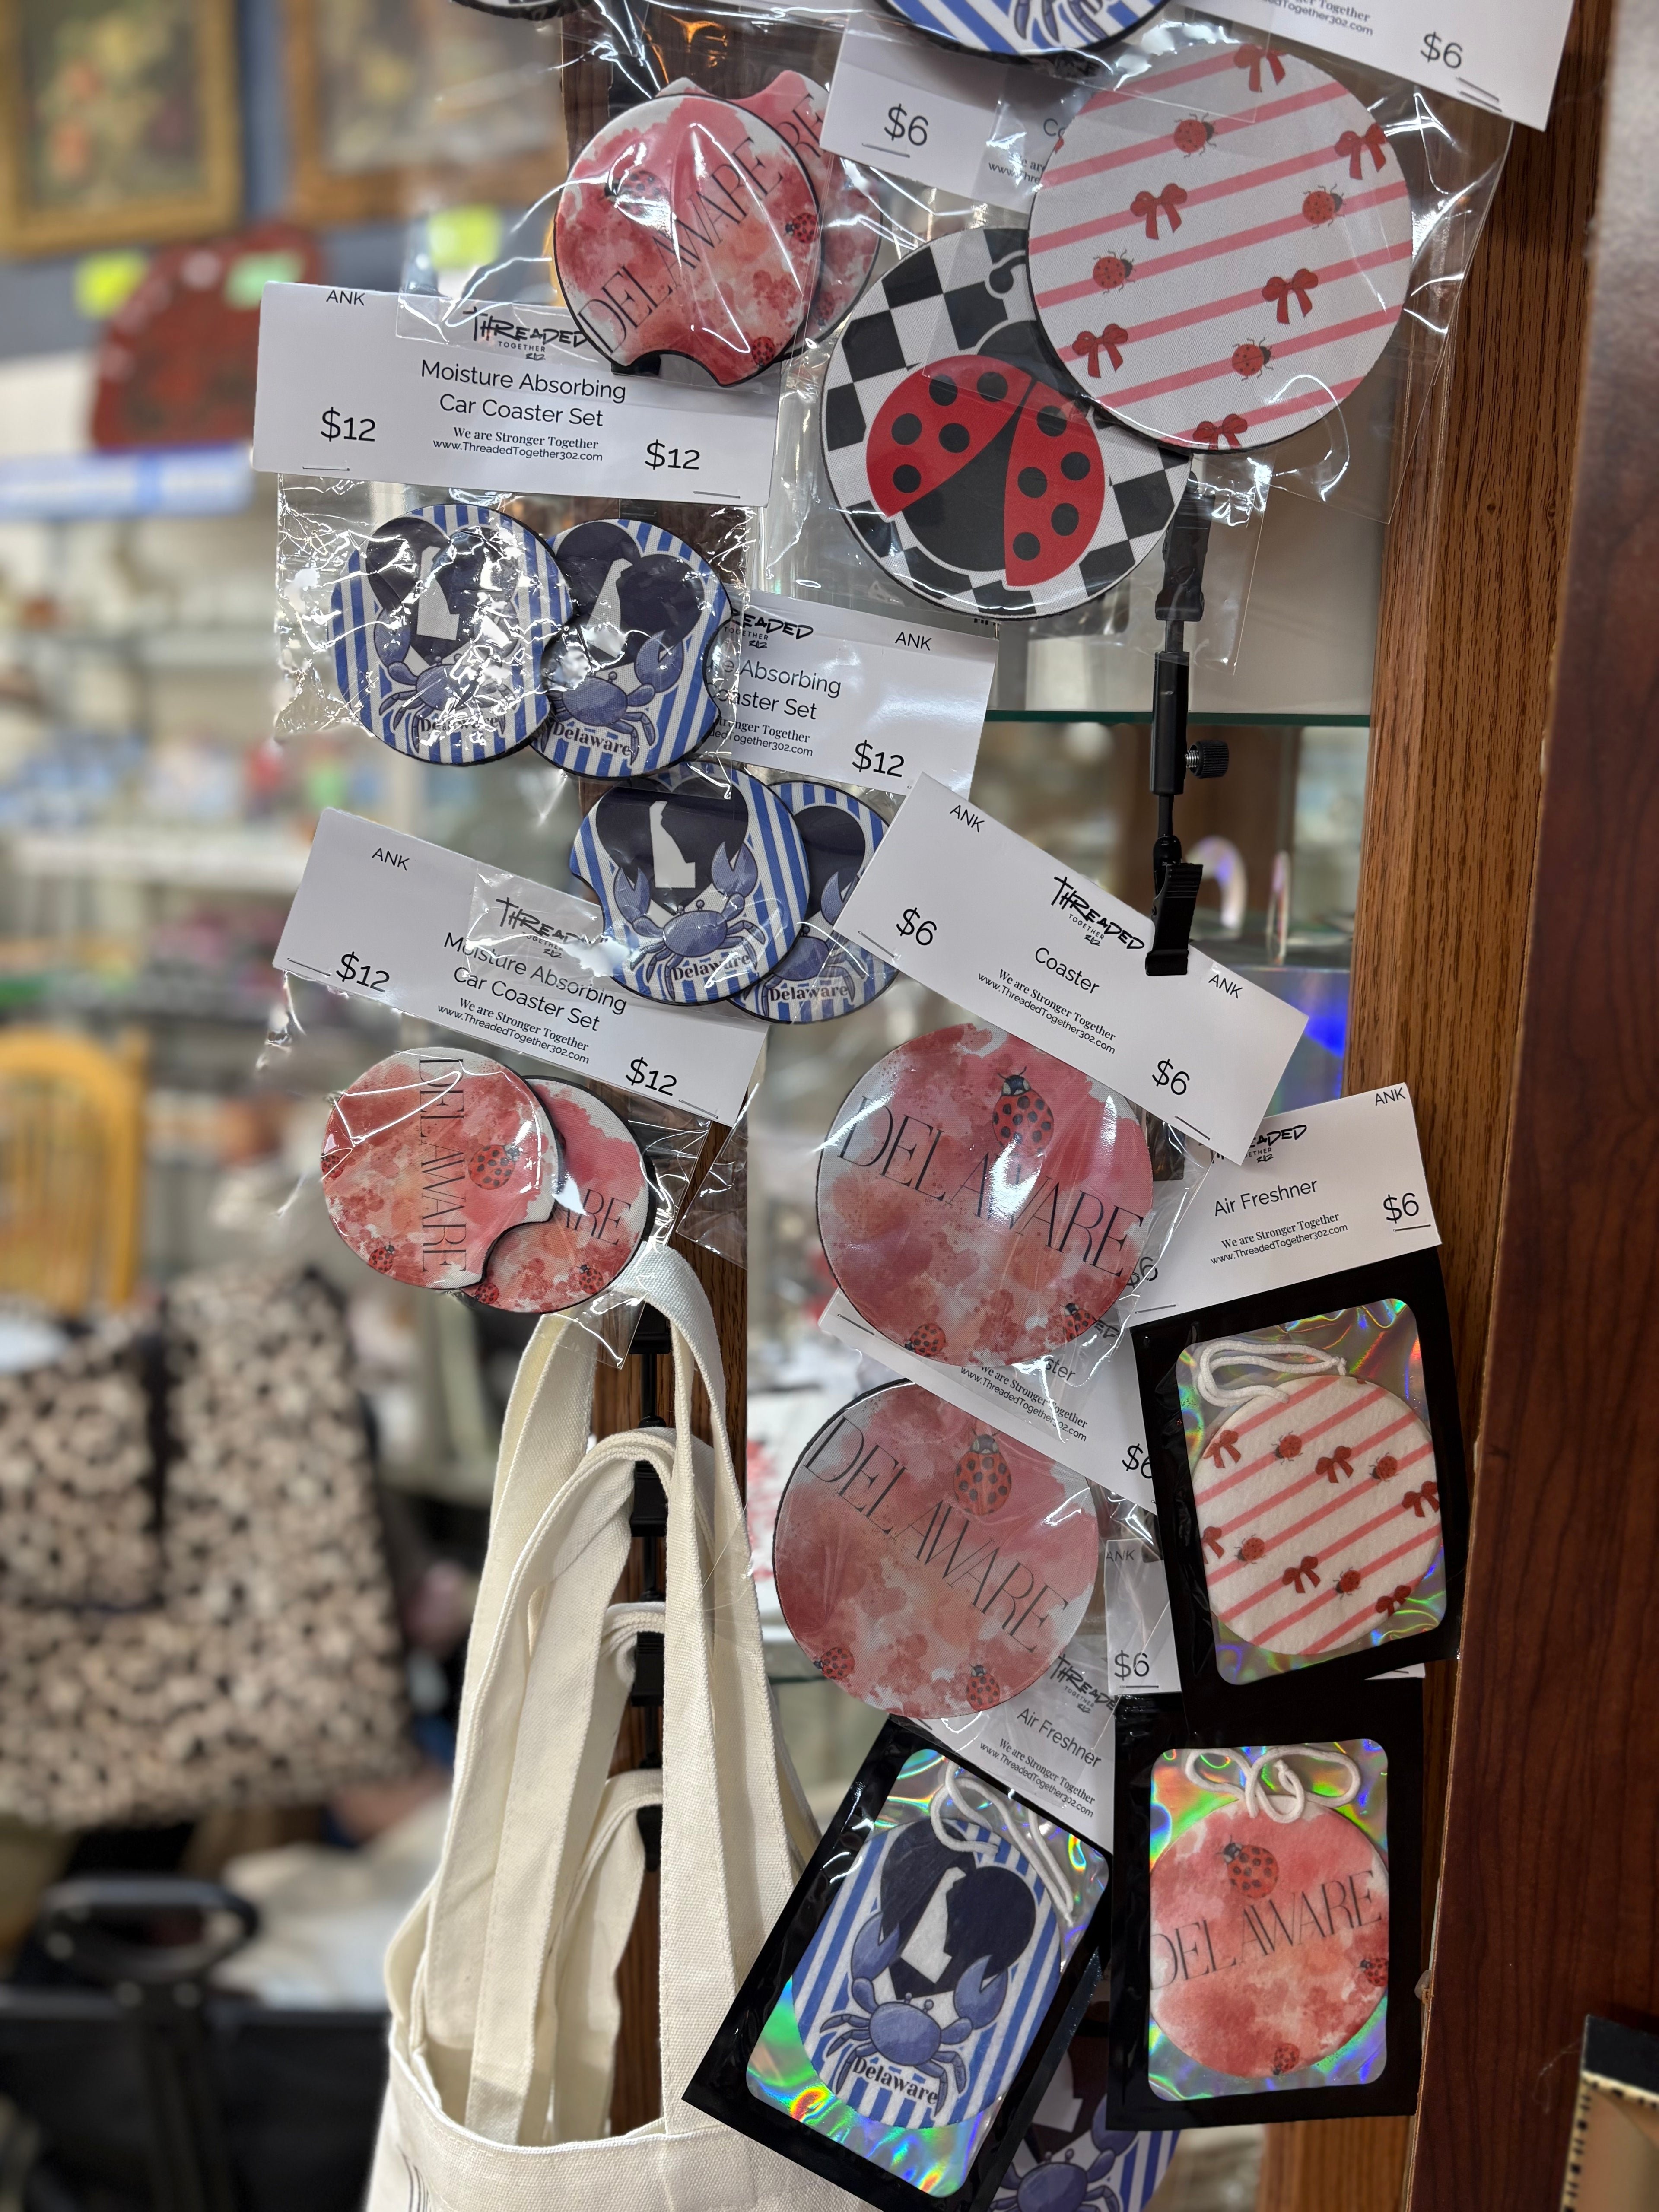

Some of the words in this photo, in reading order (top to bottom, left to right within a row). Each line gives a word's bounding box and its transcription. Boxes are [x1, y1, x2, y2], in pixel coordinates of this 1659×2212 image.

[1265, 0, 1373, 36] dTogether302.com
[1421, 31, 1463, 69] $6
[884, 103, 929, 146] $6
[578, 137, 783, 355] DELAWARE
[326, 290, 365, 306] ANK
[463, 306, 588, 348] THREADED
[499, 341, 546, 352] TOGETHER
[422, 359, 513, 388] Moisture
[519, 373, 626, 404] Absorbing
[321, 407, 376, 442] $12
[440, 394, 476, 414] Car
[483, 399, 563, 423] Coaster
[569, 408, 603, 426] Set
[433, 440, 603, 461] www.ThreadedTogether302.com
[454, 427, 471, 439] We
[474, 431, 493, 441] are
[495, 432, 545, 447] Stronger
[548, 436, 599, 450] Together
[645, 439, 700, 470] $12
[895, 632, 932, 651] ANK
[739, 660, 841, 698] Absorbing
[784, 698, 817, 720] Set
[553, 722, 630, 756] Delaware
[718, 717, 760, 733] tronger
[763, 725, 810, 743] Together
[852, 740, 905, 777] $12
[950, 804, 985, 832] ANK
[372, 848, 410, 870] ANK
[496, 897, 580, 942] THREA
[896, 907, 937, 946] $6
[1051, 876, 1145, 950] THREADED
[1069, 914, 1105, 940] TOGETHER
[336, 951, 390, 993] $12
[1035, 947, 1100, 994] Coaster
[1208, 974, 1243, 998] ANK
[454, 967, 487, 990] Car
[492, 980, 565, 1017] Coaster
[567, 1008, 601, 1031] Set
[530, 966, 627, 1015] Absorbing
[770, 984, 849, 1002] Delaware
[999, 969, 1014, 984] We
[1013, 980, 1030, 994] are
[1030, 987, 1073, 1018] Stronger
[1074, 1011, 1116, 1041] Together
[459, 998, 474, 1011] We
[477, 1006, 494, 1018] are
[496, 1012, 541, 1034] Stronger
[543, 1028, 589, 1052] Together
[978, 973, 1116, 1055] www.ThreadedTogether302.com
[438, 1005, 590, 1064] www.ThreadedTogether302.com
[625, 1057, 677, 1096] $12
[1152, 1059, 1190, 1095] $6
[1374, 1087, 1406, 1106] ANK
[419, 1058, 467, 1272] DELAWARE
[1245, 1147, 1272, 1158] ETHER
[1214, 1195, 1236, 1216] Air
[1240, 1179, 1318, 1209] Freshner
[1382, 1192, 1419, 1224] $6
[1210, 1223, 1348, 1265] www.ThreadedTogether302.com
[1221, 1236, 1237, 1249] We
[1238, 1235, 1255, 1245] are
[1255, 1223, 1297, 1242] Stronger
[1297, 1213, 1340, 1234] Together
[1046, 1357, 1076, 1381] ster
[995, 1372, 1009, 1385] are
[1010, 1379, 1048, 1406] Stronger
[804, 1416, 1068, 1653] DELAWARE
[1106, 1549, 1135, 1562] ANK
[1050, 1654, 1116, 1711] THREADE
[1114, 1649, 1150, 1681] $6
[1064, 1686, 1095, 1707] TOGETHER
[1017, 1708, 1039, 1728] Air
[1039, 1721, 1101, 1767] Freshner
[980, 1741, 1093, 1818] www.ThreadedTogether302.com
[999, 1738, 1012, 1754] We
[1012, 1748, 1026, 1762] are
[1026, 1754, 1060, 1783] Stronger
[1060, 1776, 1096, 1806] Together
[852, 2057, 938, 2105] Delaware
